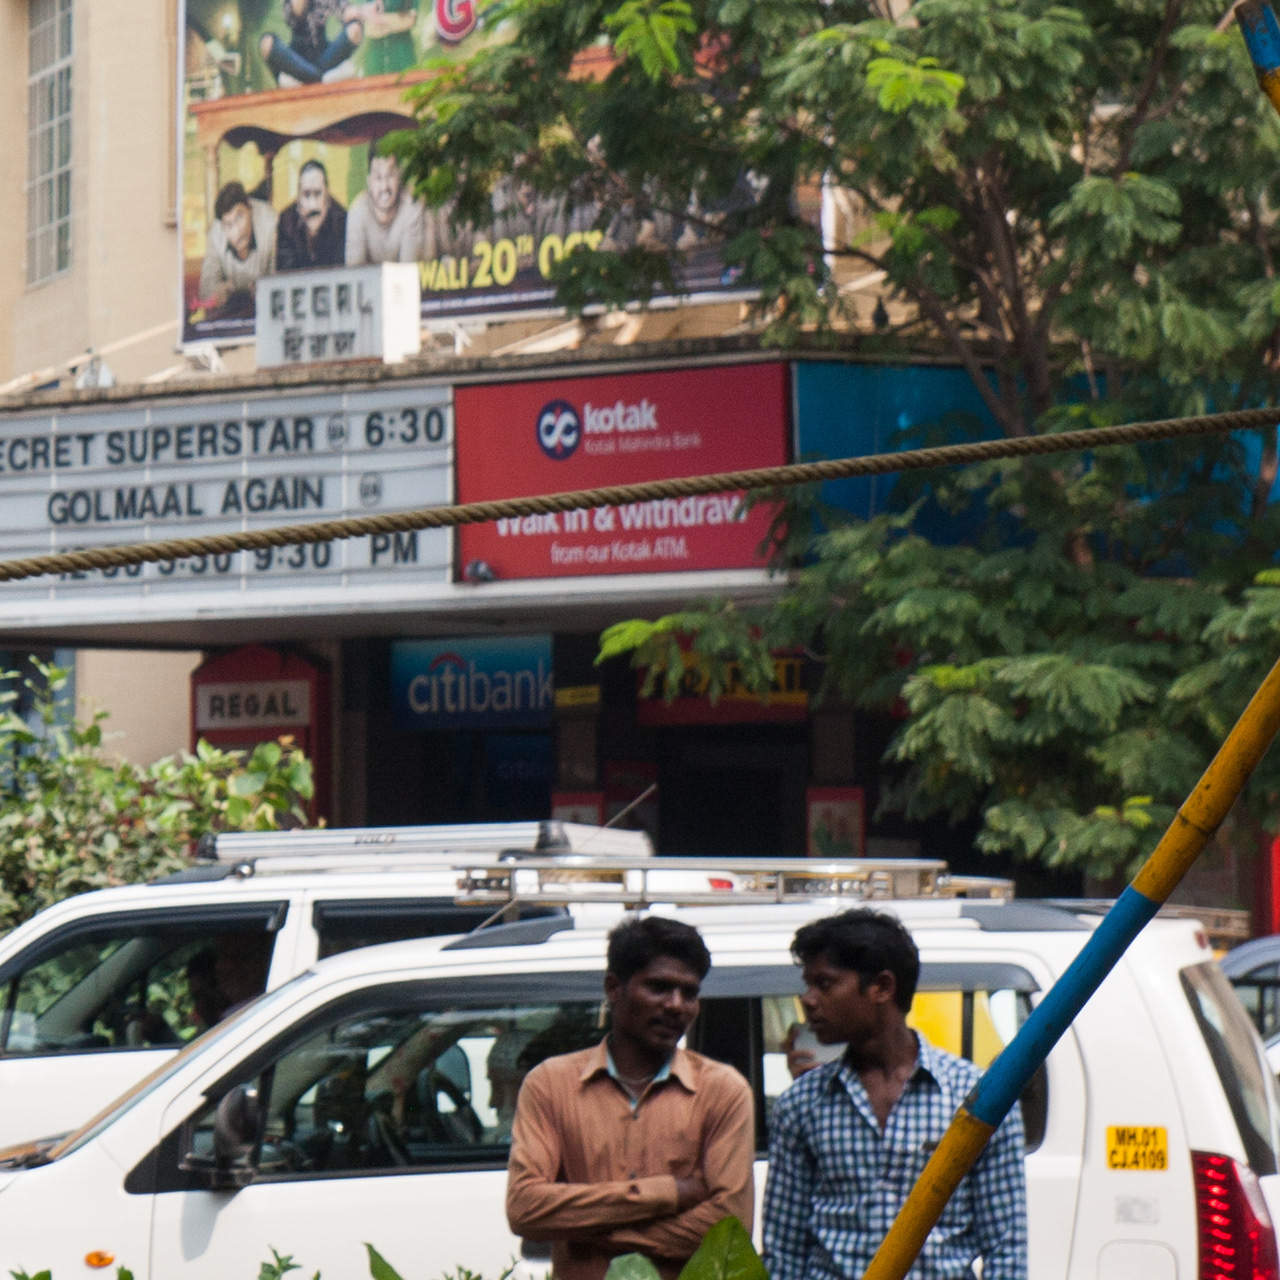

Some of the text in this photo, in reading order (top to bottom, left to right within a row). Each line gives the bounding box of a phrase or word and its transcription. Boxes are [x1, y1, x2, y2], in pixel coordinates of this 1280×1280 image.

[106, 418, 315, 465] SUPERSTAR
[365, 407, 444, 447] 6:30
[583, 398, 658, 434] kotak
[46, 487, 203, 524] GOLMAAL
[220, 476, 324, 515] AGAIN
[371, 532, 418, 565] PM
[209, 690, 298, 719] REGAL
[408, 658, 553, 713] citibank
